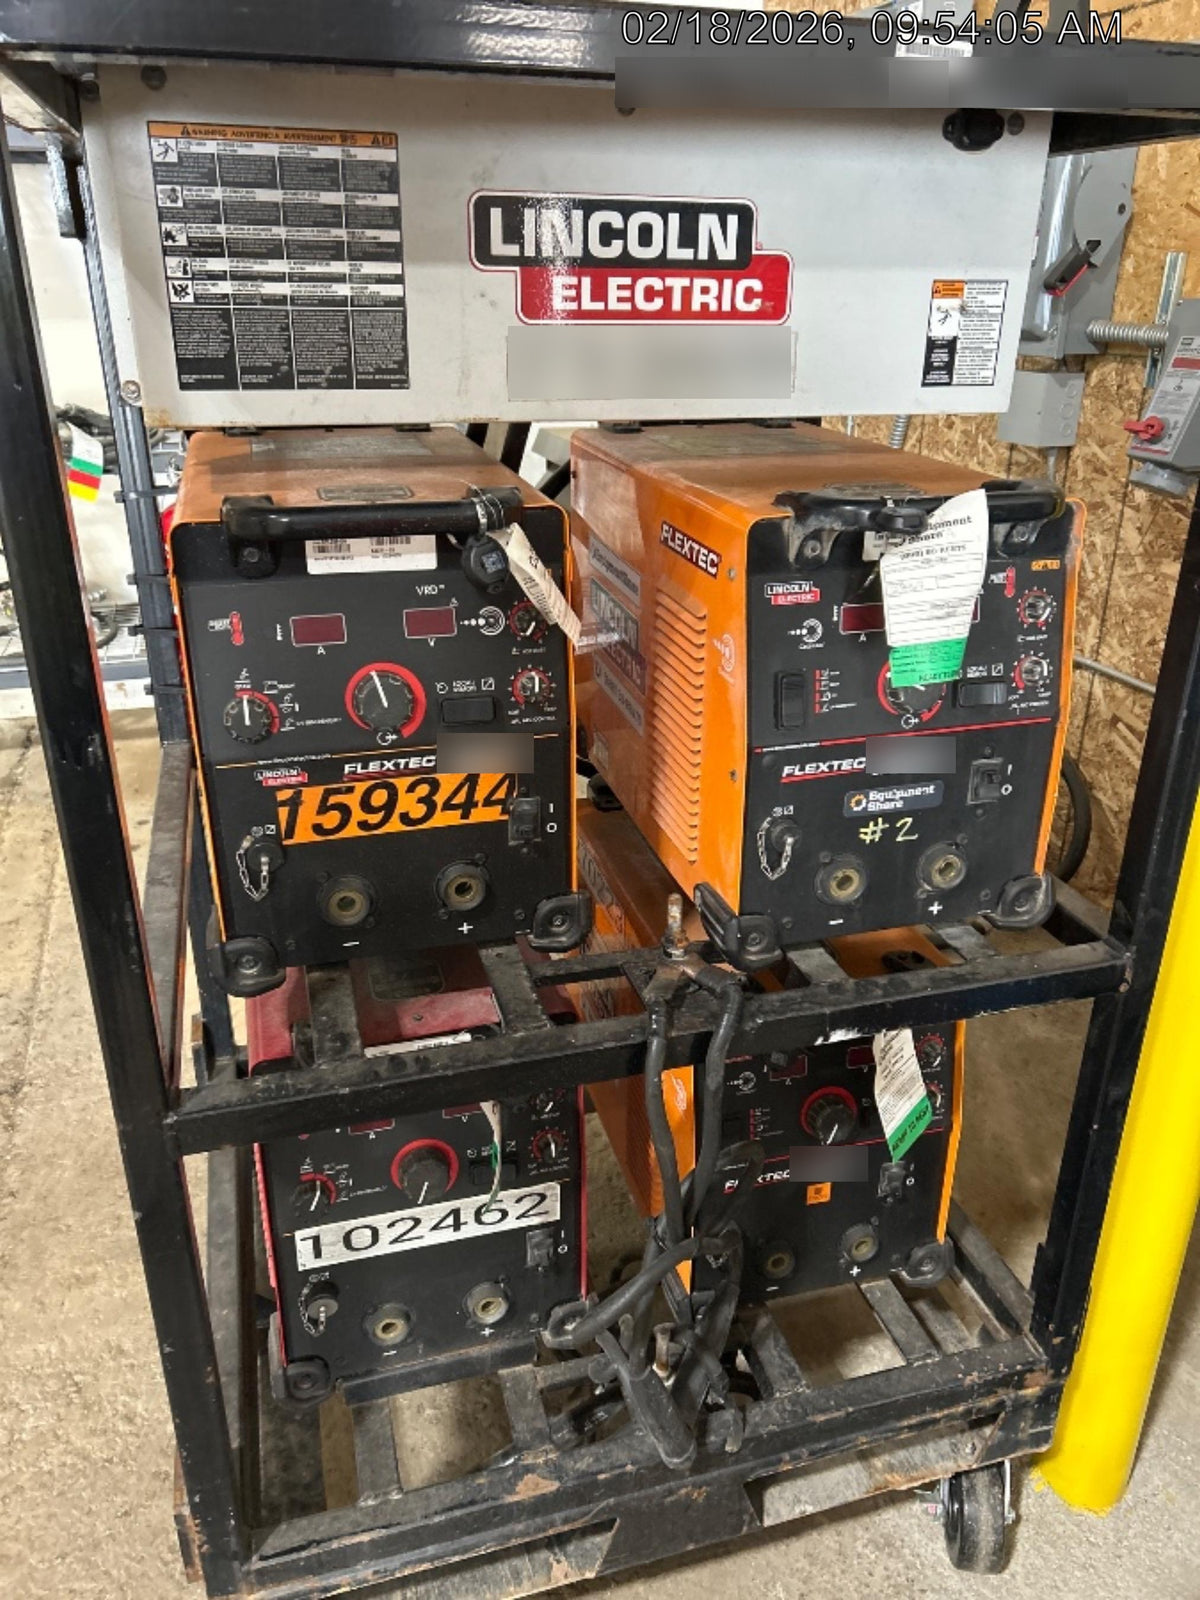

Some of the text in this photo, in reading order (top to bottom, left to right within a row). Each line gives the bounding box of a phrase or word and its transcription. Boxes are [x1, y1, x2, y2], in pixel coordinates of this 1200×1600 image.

[490, 206, 739, 261] LINCOLN
[552, 275, 764, 312] ELECTRIC
[660, 523, 719, 576] FLEXTEC
[766, 584, 811, 595] LINCOLN
[256, 768, 299, 780] LINCOLN
[344, 755, 437, 775] FLEXTEC
[781, 757, 867, 778] FLEXTEC
[278, 772, 516, 840] 159344
[867, 799, 904, 812] Share
[300, 1192, 550, 1260] 102462
